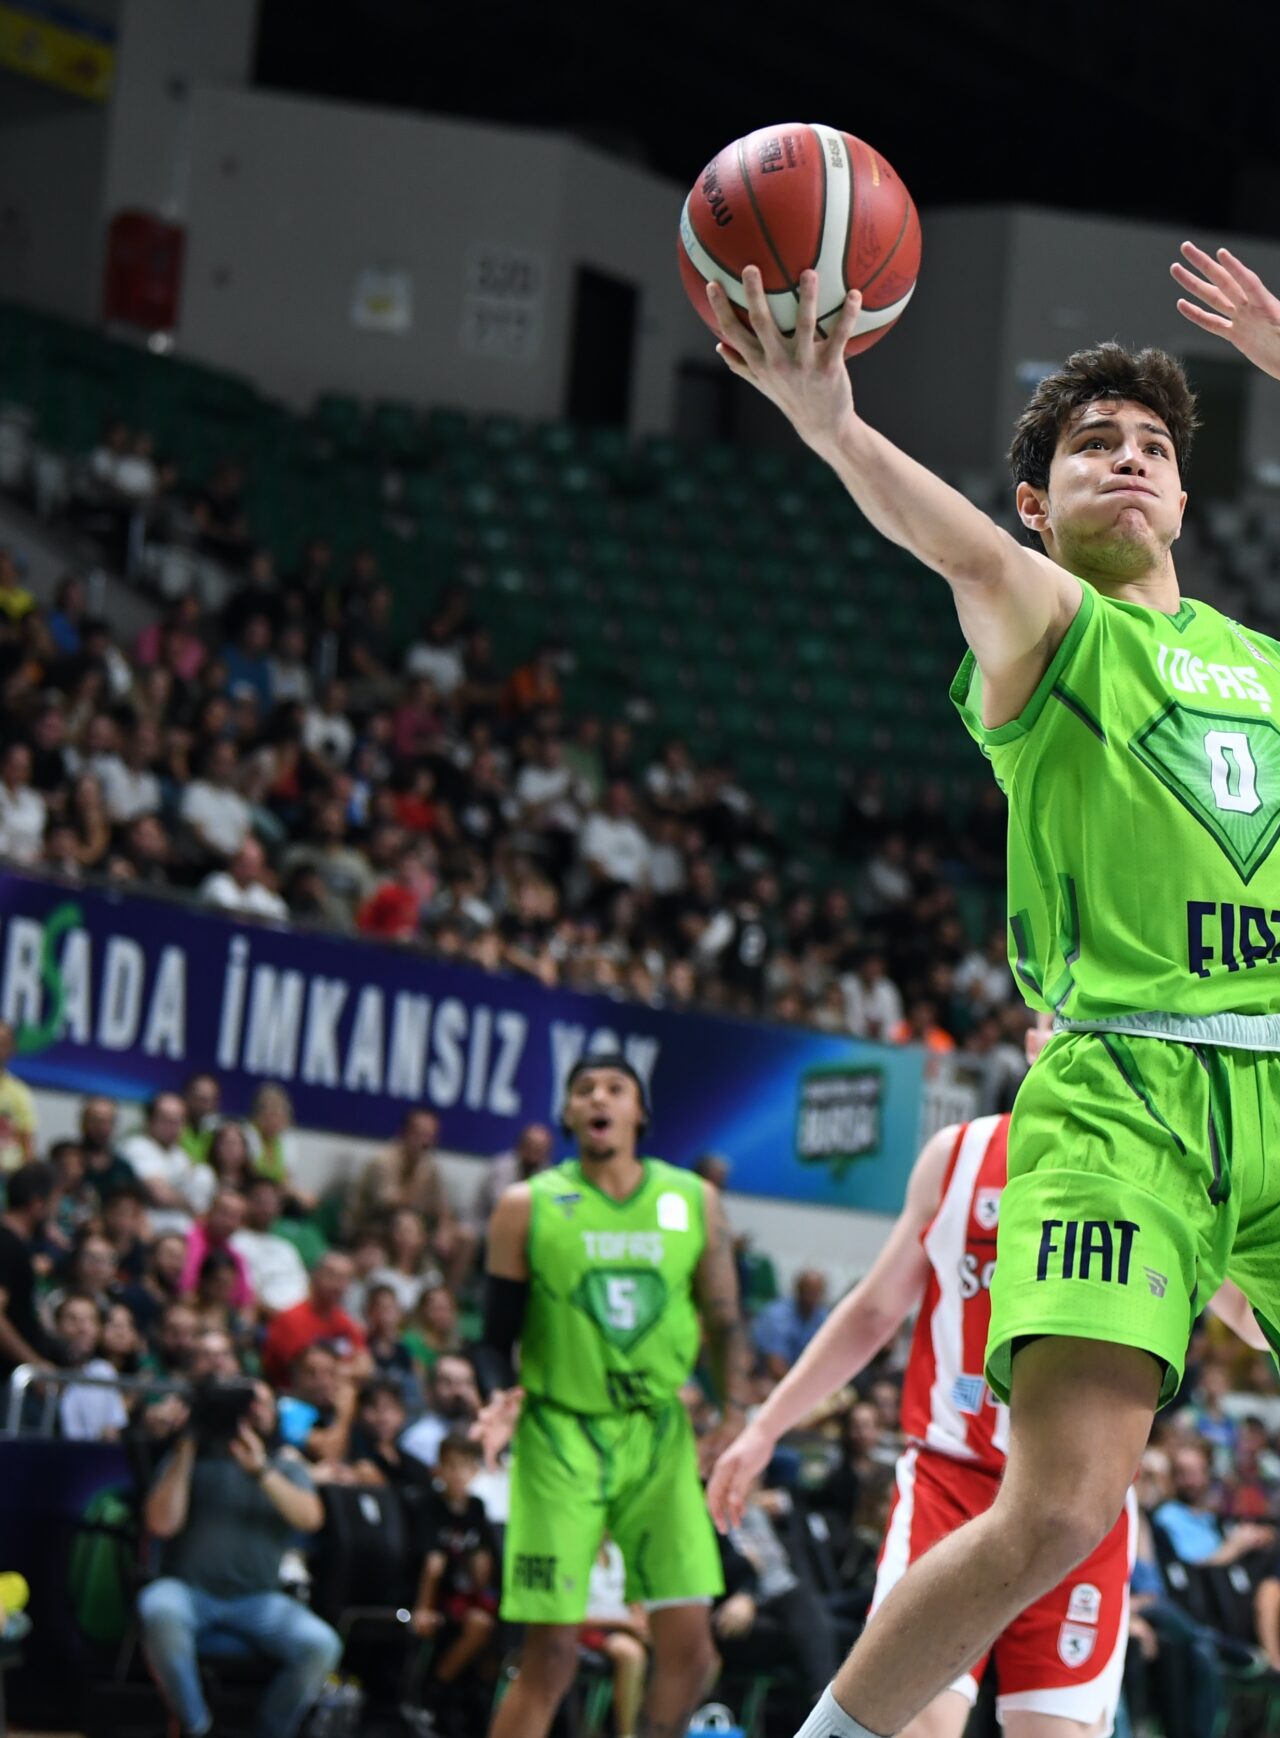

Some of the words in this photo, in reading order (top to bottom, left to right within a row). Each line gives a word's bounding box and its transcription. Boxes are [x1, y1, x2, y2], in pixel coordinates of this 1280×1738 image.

[1203, 729, 1263, 816] 0
[217, 933, 527, 1118] İMKANSIZ
[1036, 1219, 1141, 1286] FIAT
[605, 1277, 637, 1330] 5
